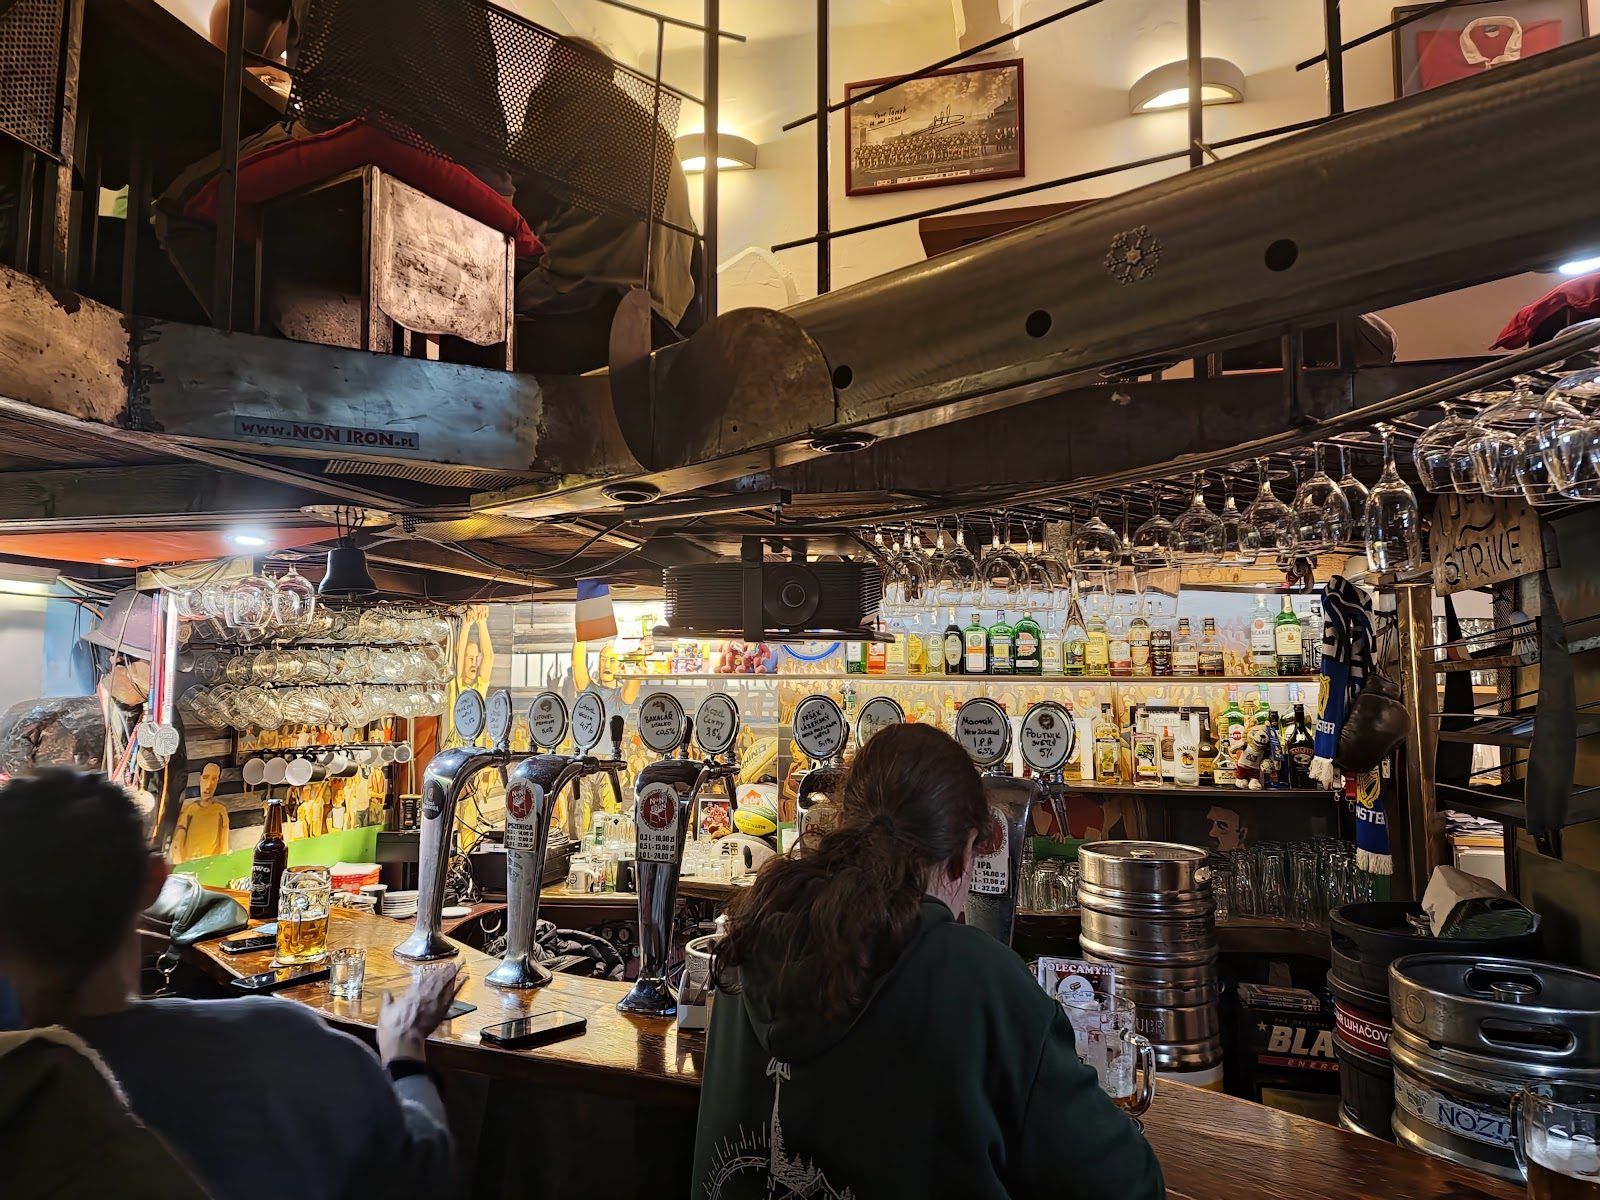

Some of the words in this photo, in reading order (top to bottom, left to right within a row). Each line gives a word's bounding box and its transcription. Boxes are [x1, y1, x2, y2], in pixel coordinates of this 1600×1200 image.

[1316, 719, 1336, 734] STER
[977, 861, 992, 869] IPA
[1344, 1016, 1392, 1042] LUHAČOV
[1268, 1024, 1336, 1058] BLA
[1287, 1058, 1340, 1071] ENERG
